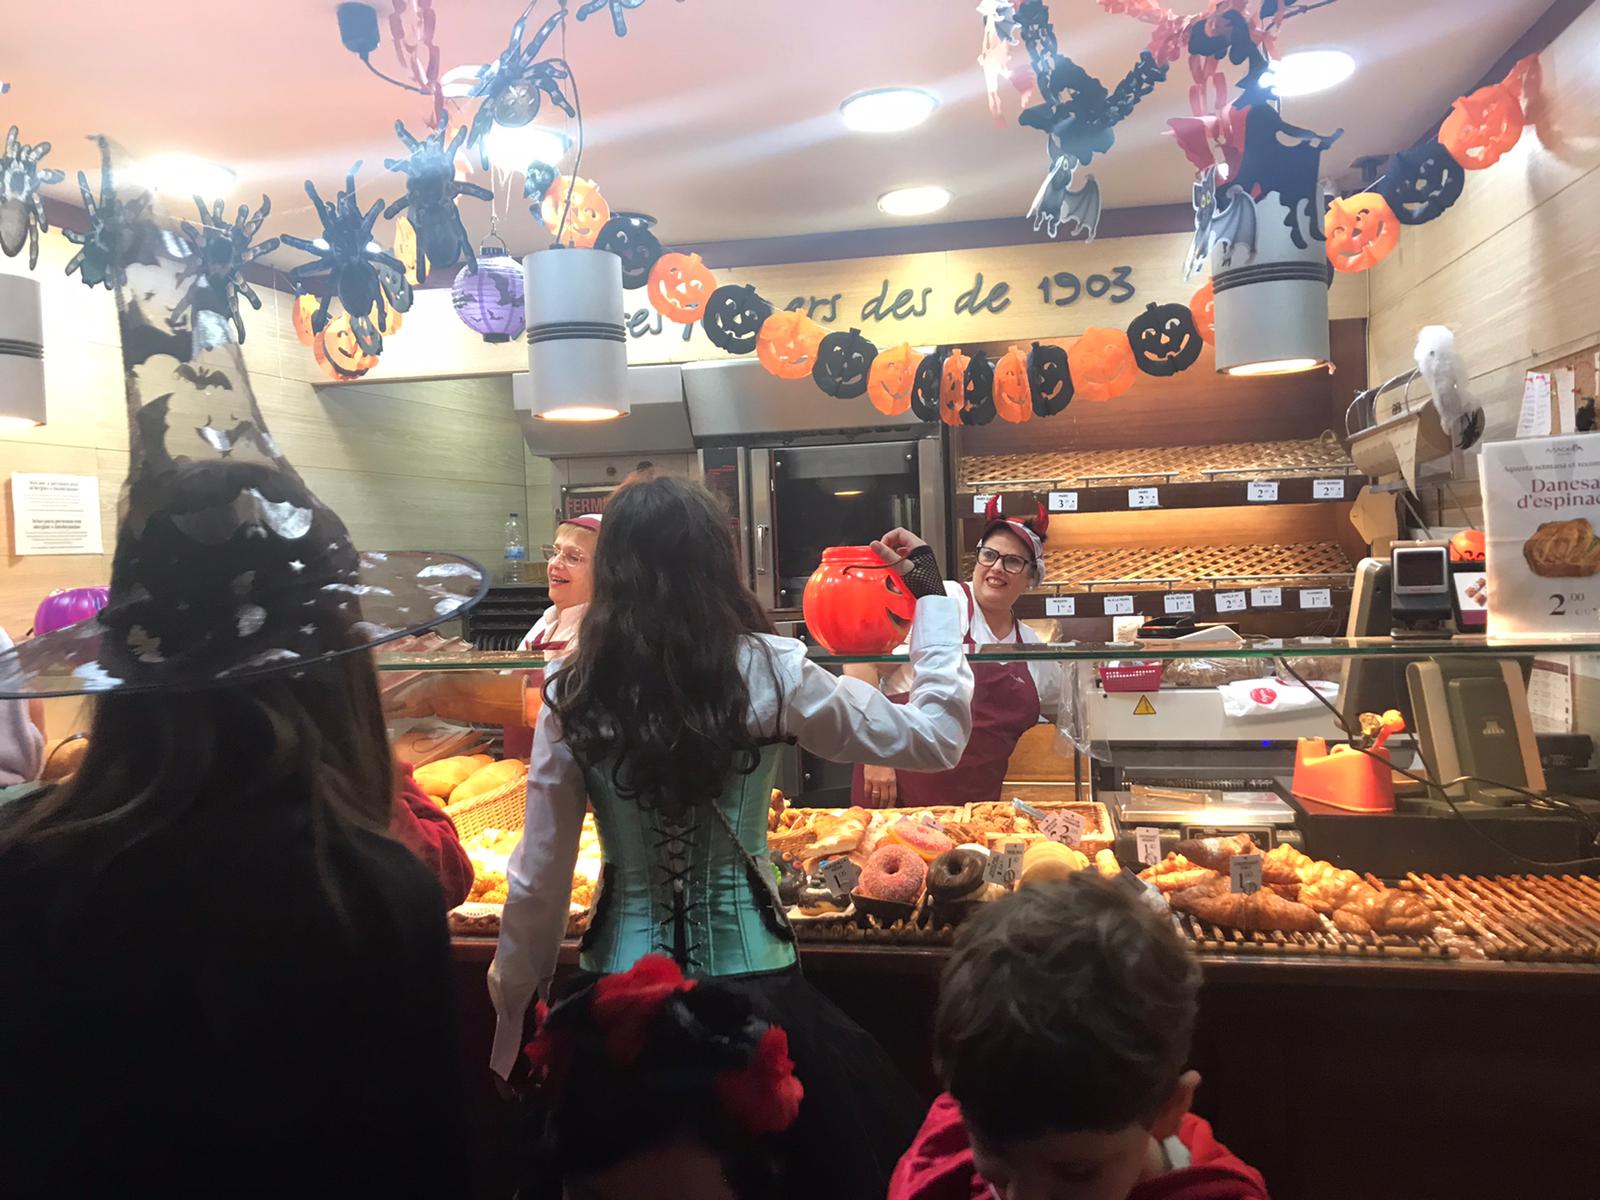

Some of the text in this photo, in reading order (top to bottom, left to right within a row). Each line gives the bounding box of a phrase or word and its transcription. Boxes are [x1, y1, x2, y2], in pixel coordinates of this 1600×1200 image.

[861, 279, 932, 322] des
[954, 272, 1012, 316] de
[1038, 265, 1136, 306] 1903
[1531, 478, 1600, 494] Danesa
[1549, 594, 1566, 616] 2
